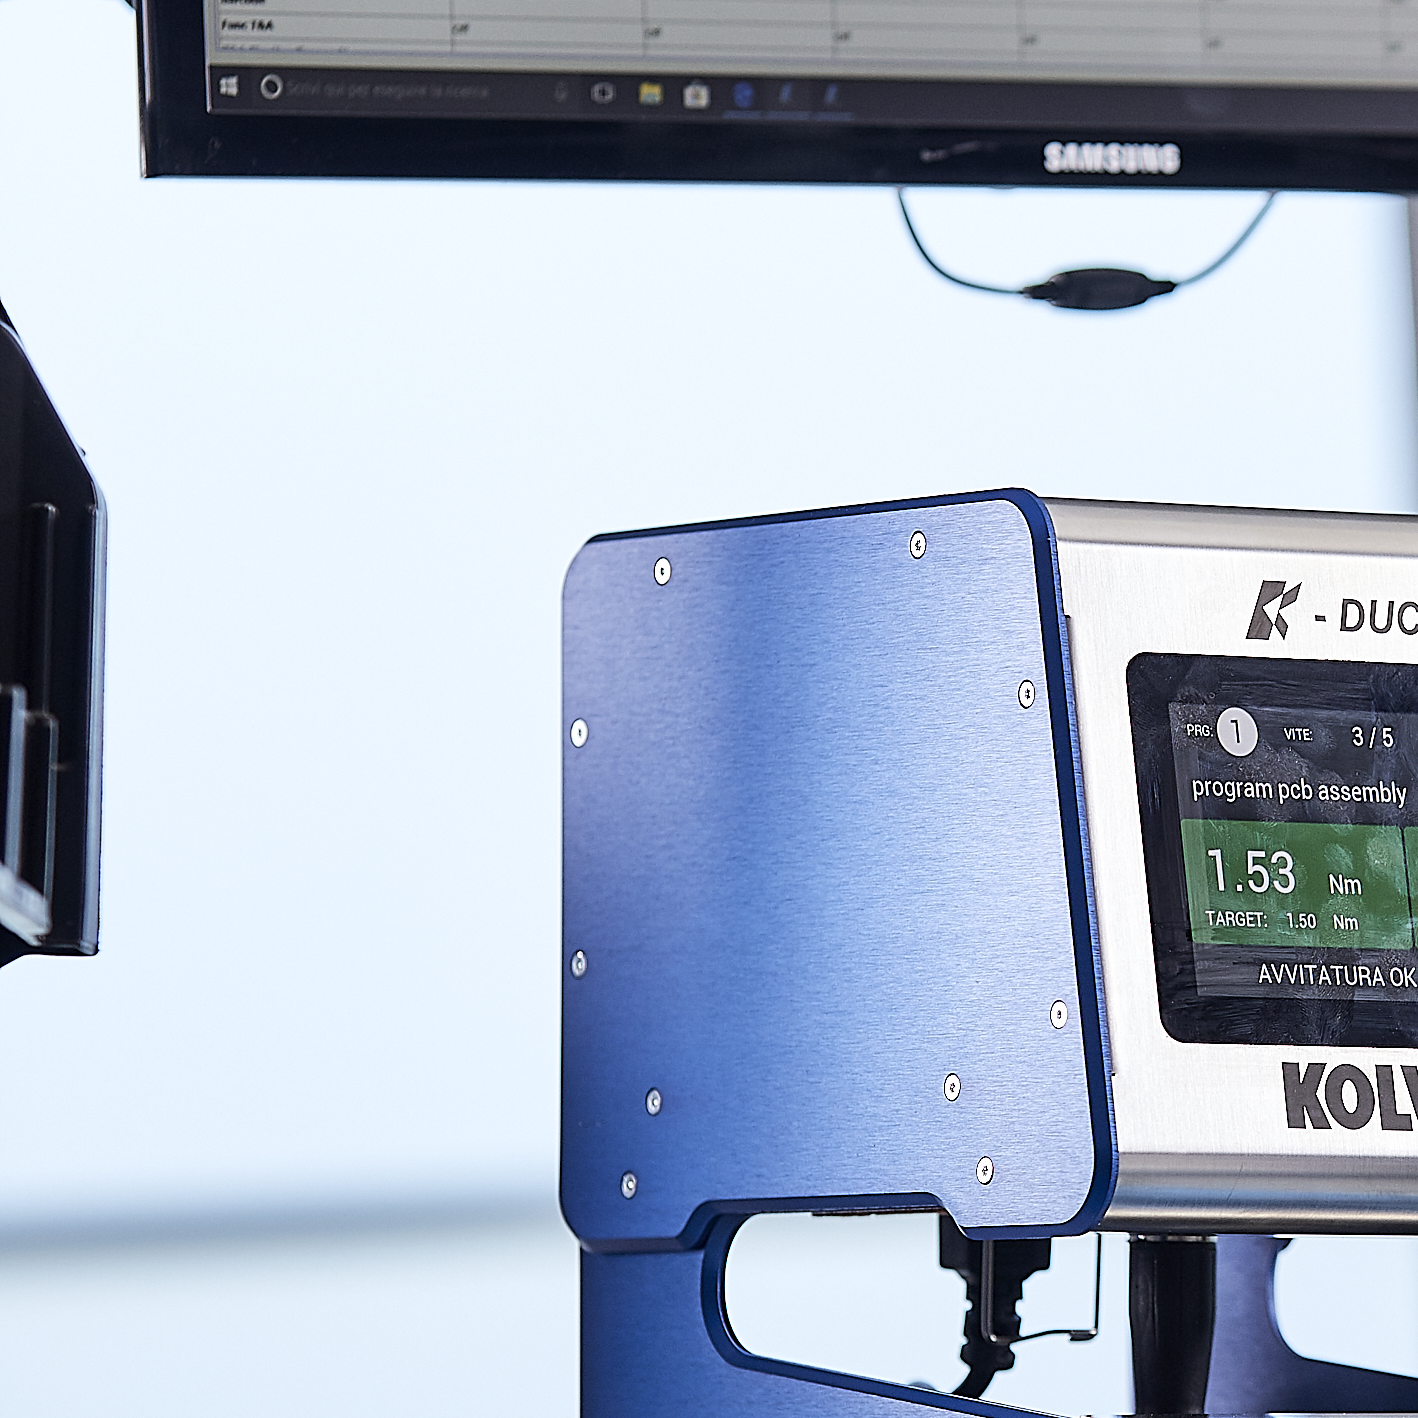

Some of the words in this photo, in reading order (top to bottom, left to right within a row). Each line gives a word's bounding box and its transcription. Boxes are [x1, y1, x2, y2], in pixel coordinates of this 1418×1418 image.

[1043, 141, 1182, 175] SAMSUNG
[1186, 723, 1215, 738] PRG:
[1230, 719, 1241, 744] 1
[1283, 727, 1314, 742] VITE:
[1351, 726, 1364, 747] 3
[1368, 726, 1378, 749] /
[1382, 727, 1395, 748] 5
[1191, 778, 1274, 803] program
[1278, 777, 1313, 805] pcb
[1317, 780, 1408, 809] assembly
[1207, 848, 1297, 894] 1.53
[1328, 873, 1363, 895] Nm
[1205, 909, 1269, 928] TARGET:
[1286, 912, 1317, 929] 1.50
[1332, 914, 1360, 931] Nm
[1258, 963, 1386, 988] AVVITATURA
[1390, 966, 1418, 989] OK
